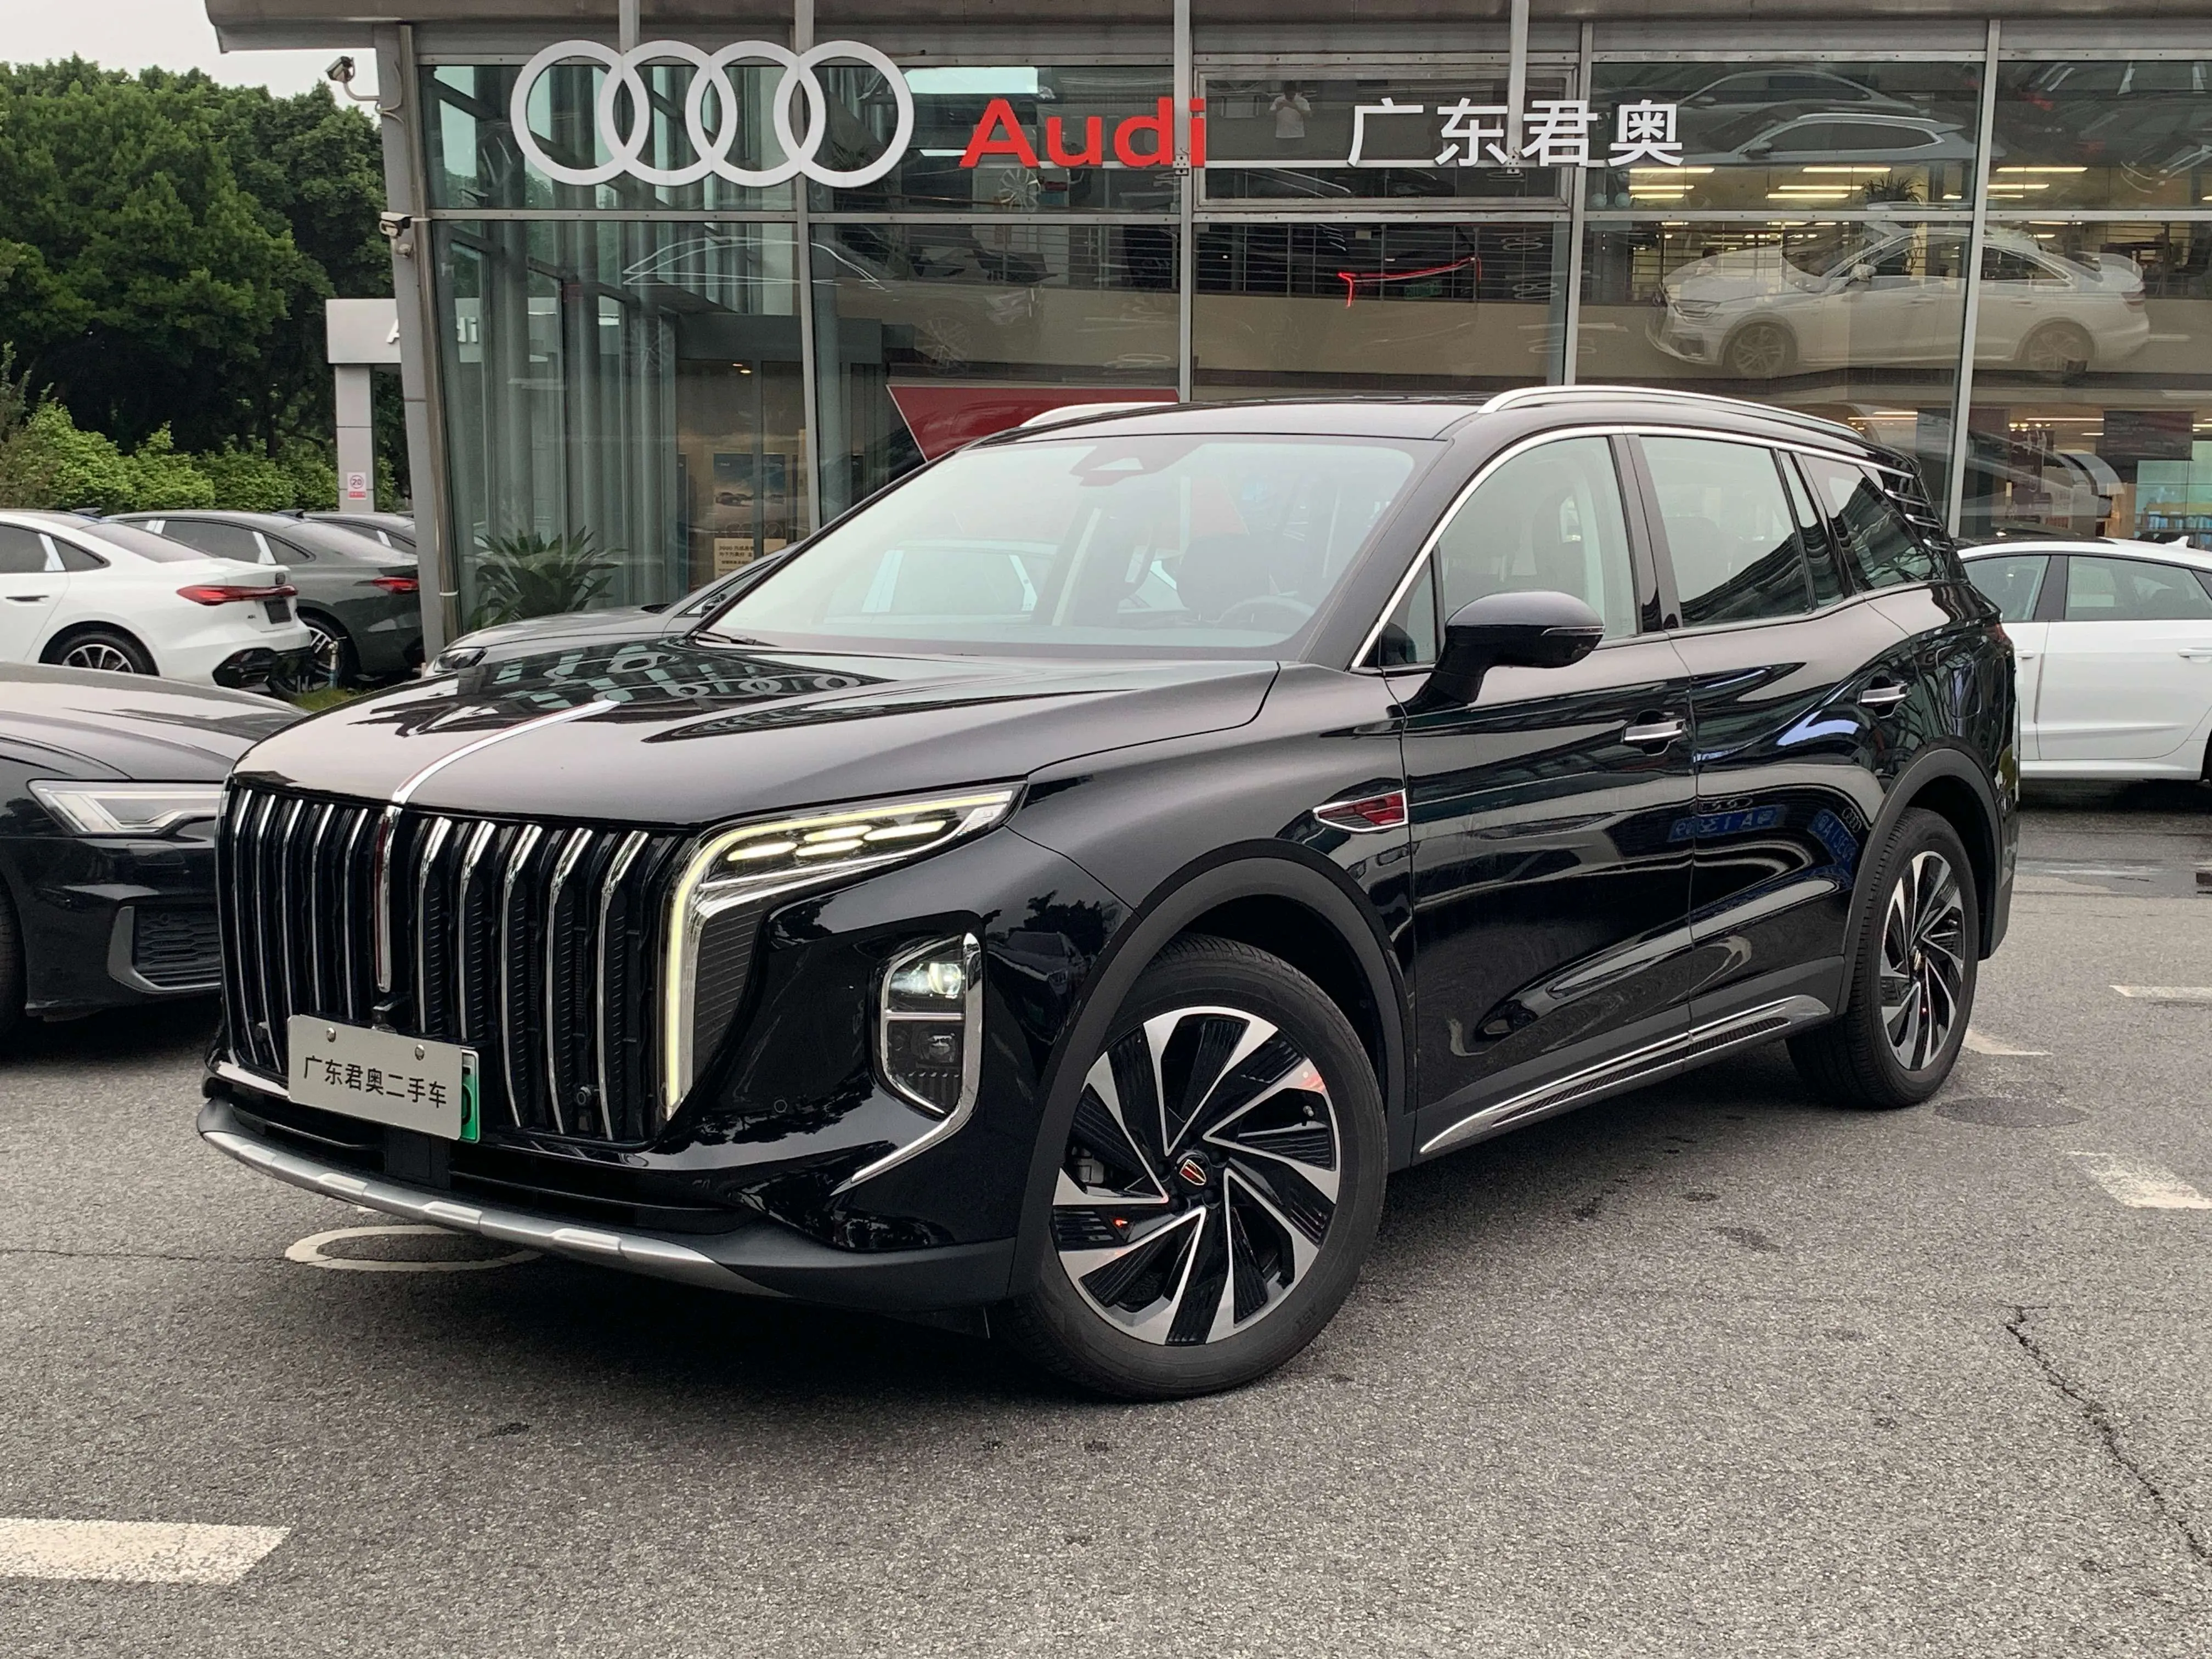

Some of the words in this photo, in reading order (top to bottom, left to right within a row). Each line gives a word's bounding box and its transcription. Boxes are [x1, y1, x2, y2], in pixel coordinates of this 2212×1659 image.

[958, 98, 1206, 168] Audi
[1347, 97, 1684, 168] 广东君奥
[303, 1056, 447, 1109] 广东君奥二手车
